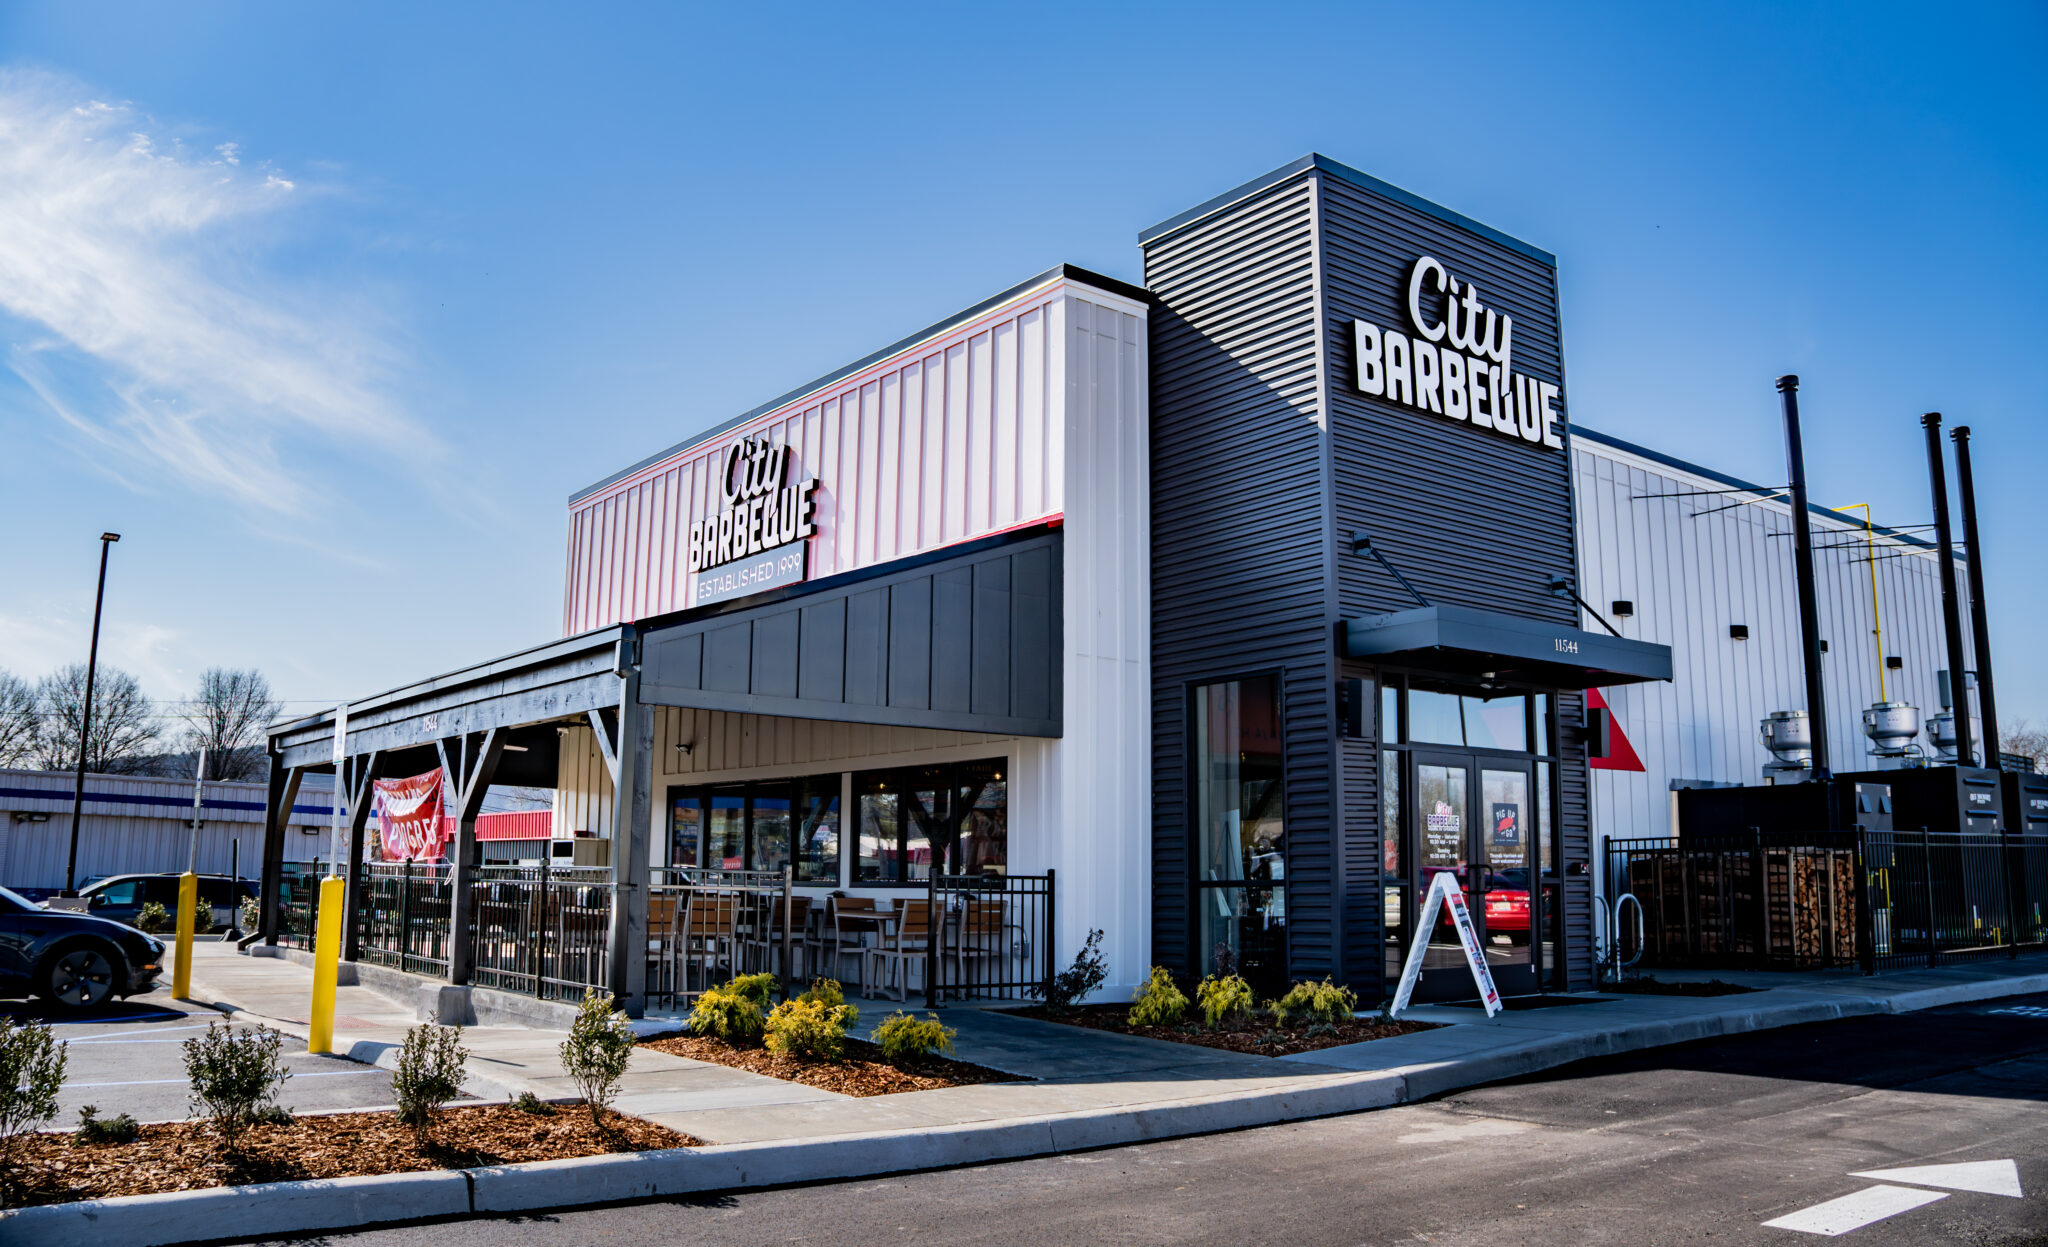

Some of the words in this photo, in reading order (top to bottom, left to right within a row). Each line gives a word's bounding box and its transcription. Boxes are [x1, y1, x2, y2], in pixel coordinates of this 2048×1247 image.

[1409, 256, 1512, 397] City
[1355, 318, 1563, 450] BARBEQUE
[722, 438, 785, 518] City
[689, 478, 814, 573] BARBEQUE
[699, 562, 774, 599] ESTABLISHED
[777, 552, 801, 577] 1999
[1554, 637, 1579, 654] 11544
